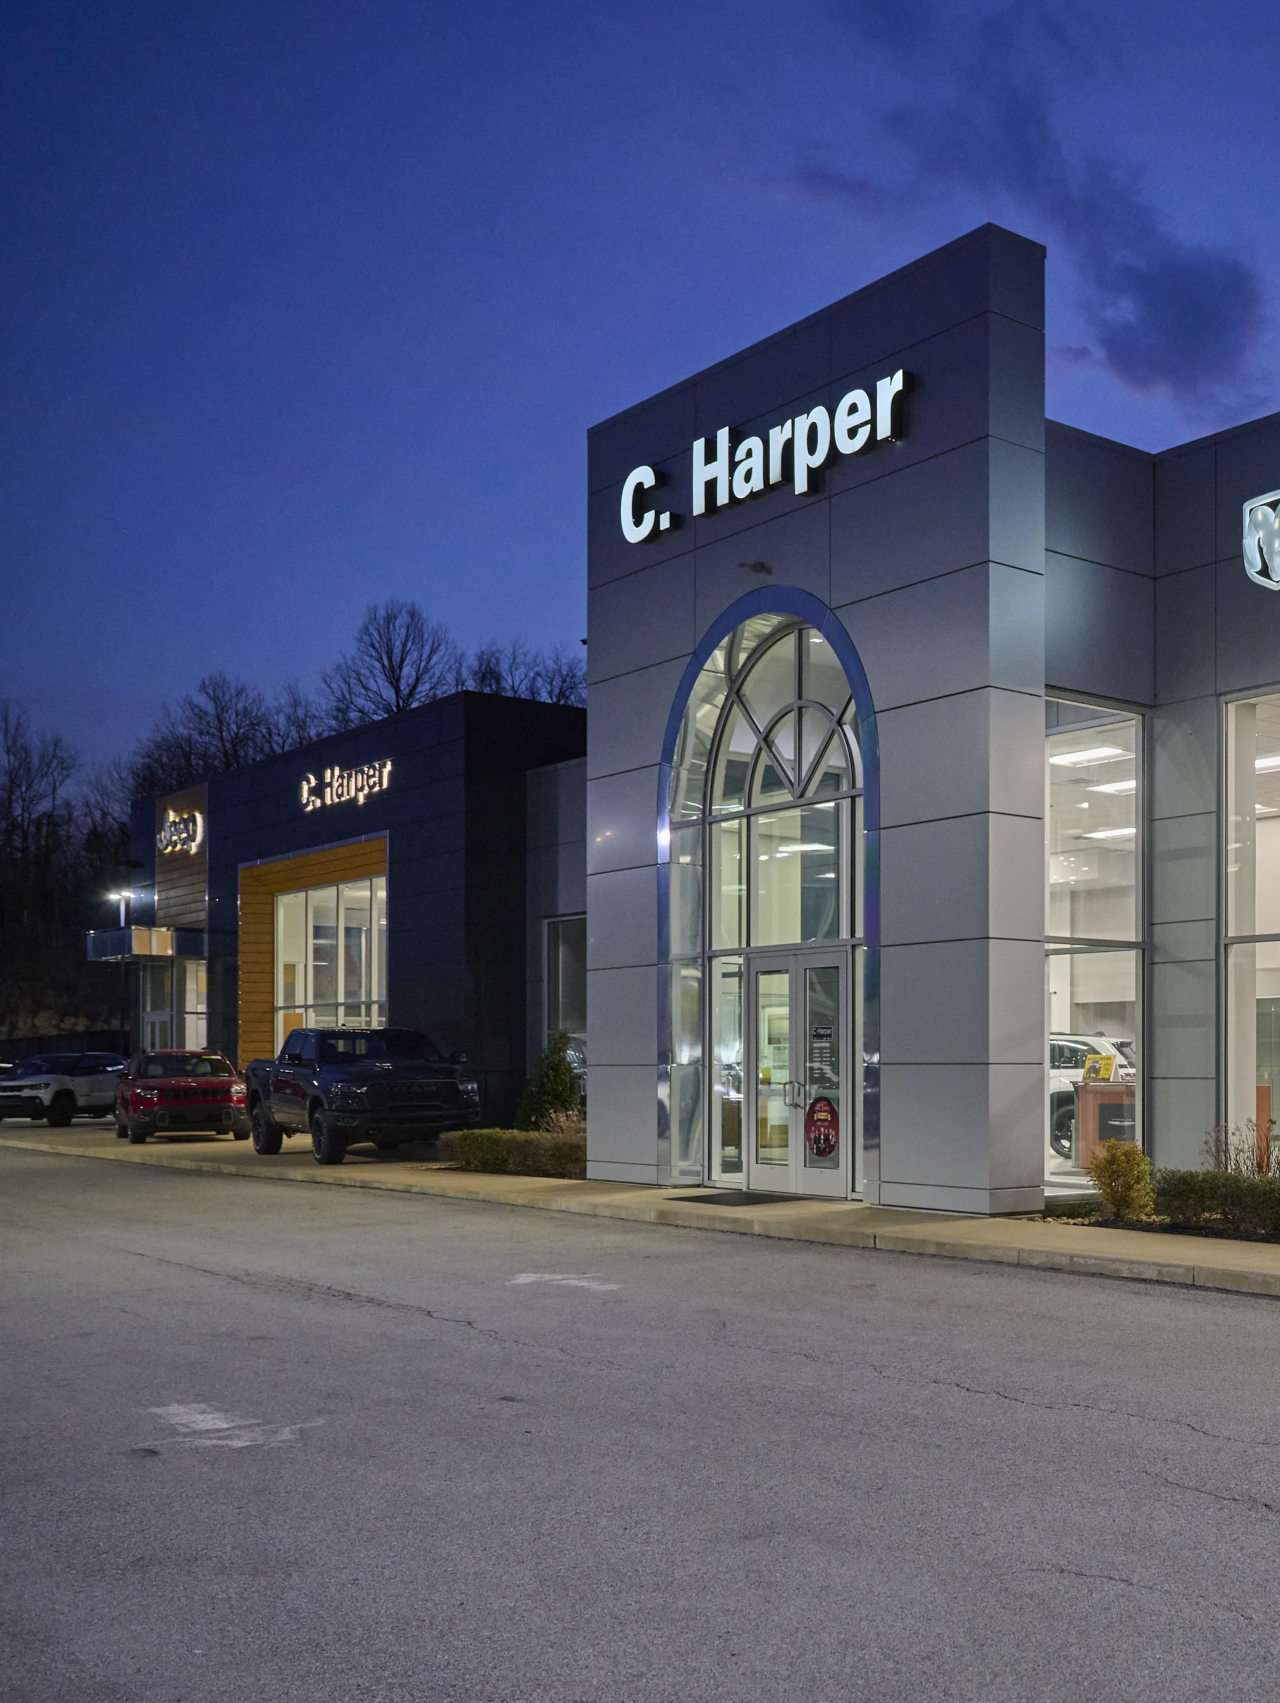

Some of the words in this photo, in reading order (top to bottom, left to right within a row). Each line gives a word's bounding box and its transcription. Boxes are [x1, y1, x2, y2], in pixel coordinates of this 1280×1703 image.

[621, 466, 671, 543] C.
[693, 369, 903, 516] Harper
[301, 773, 322, 811] C.
[324, 760, 392, 805] Harper
[157, 810, 204, 855] Jeep
